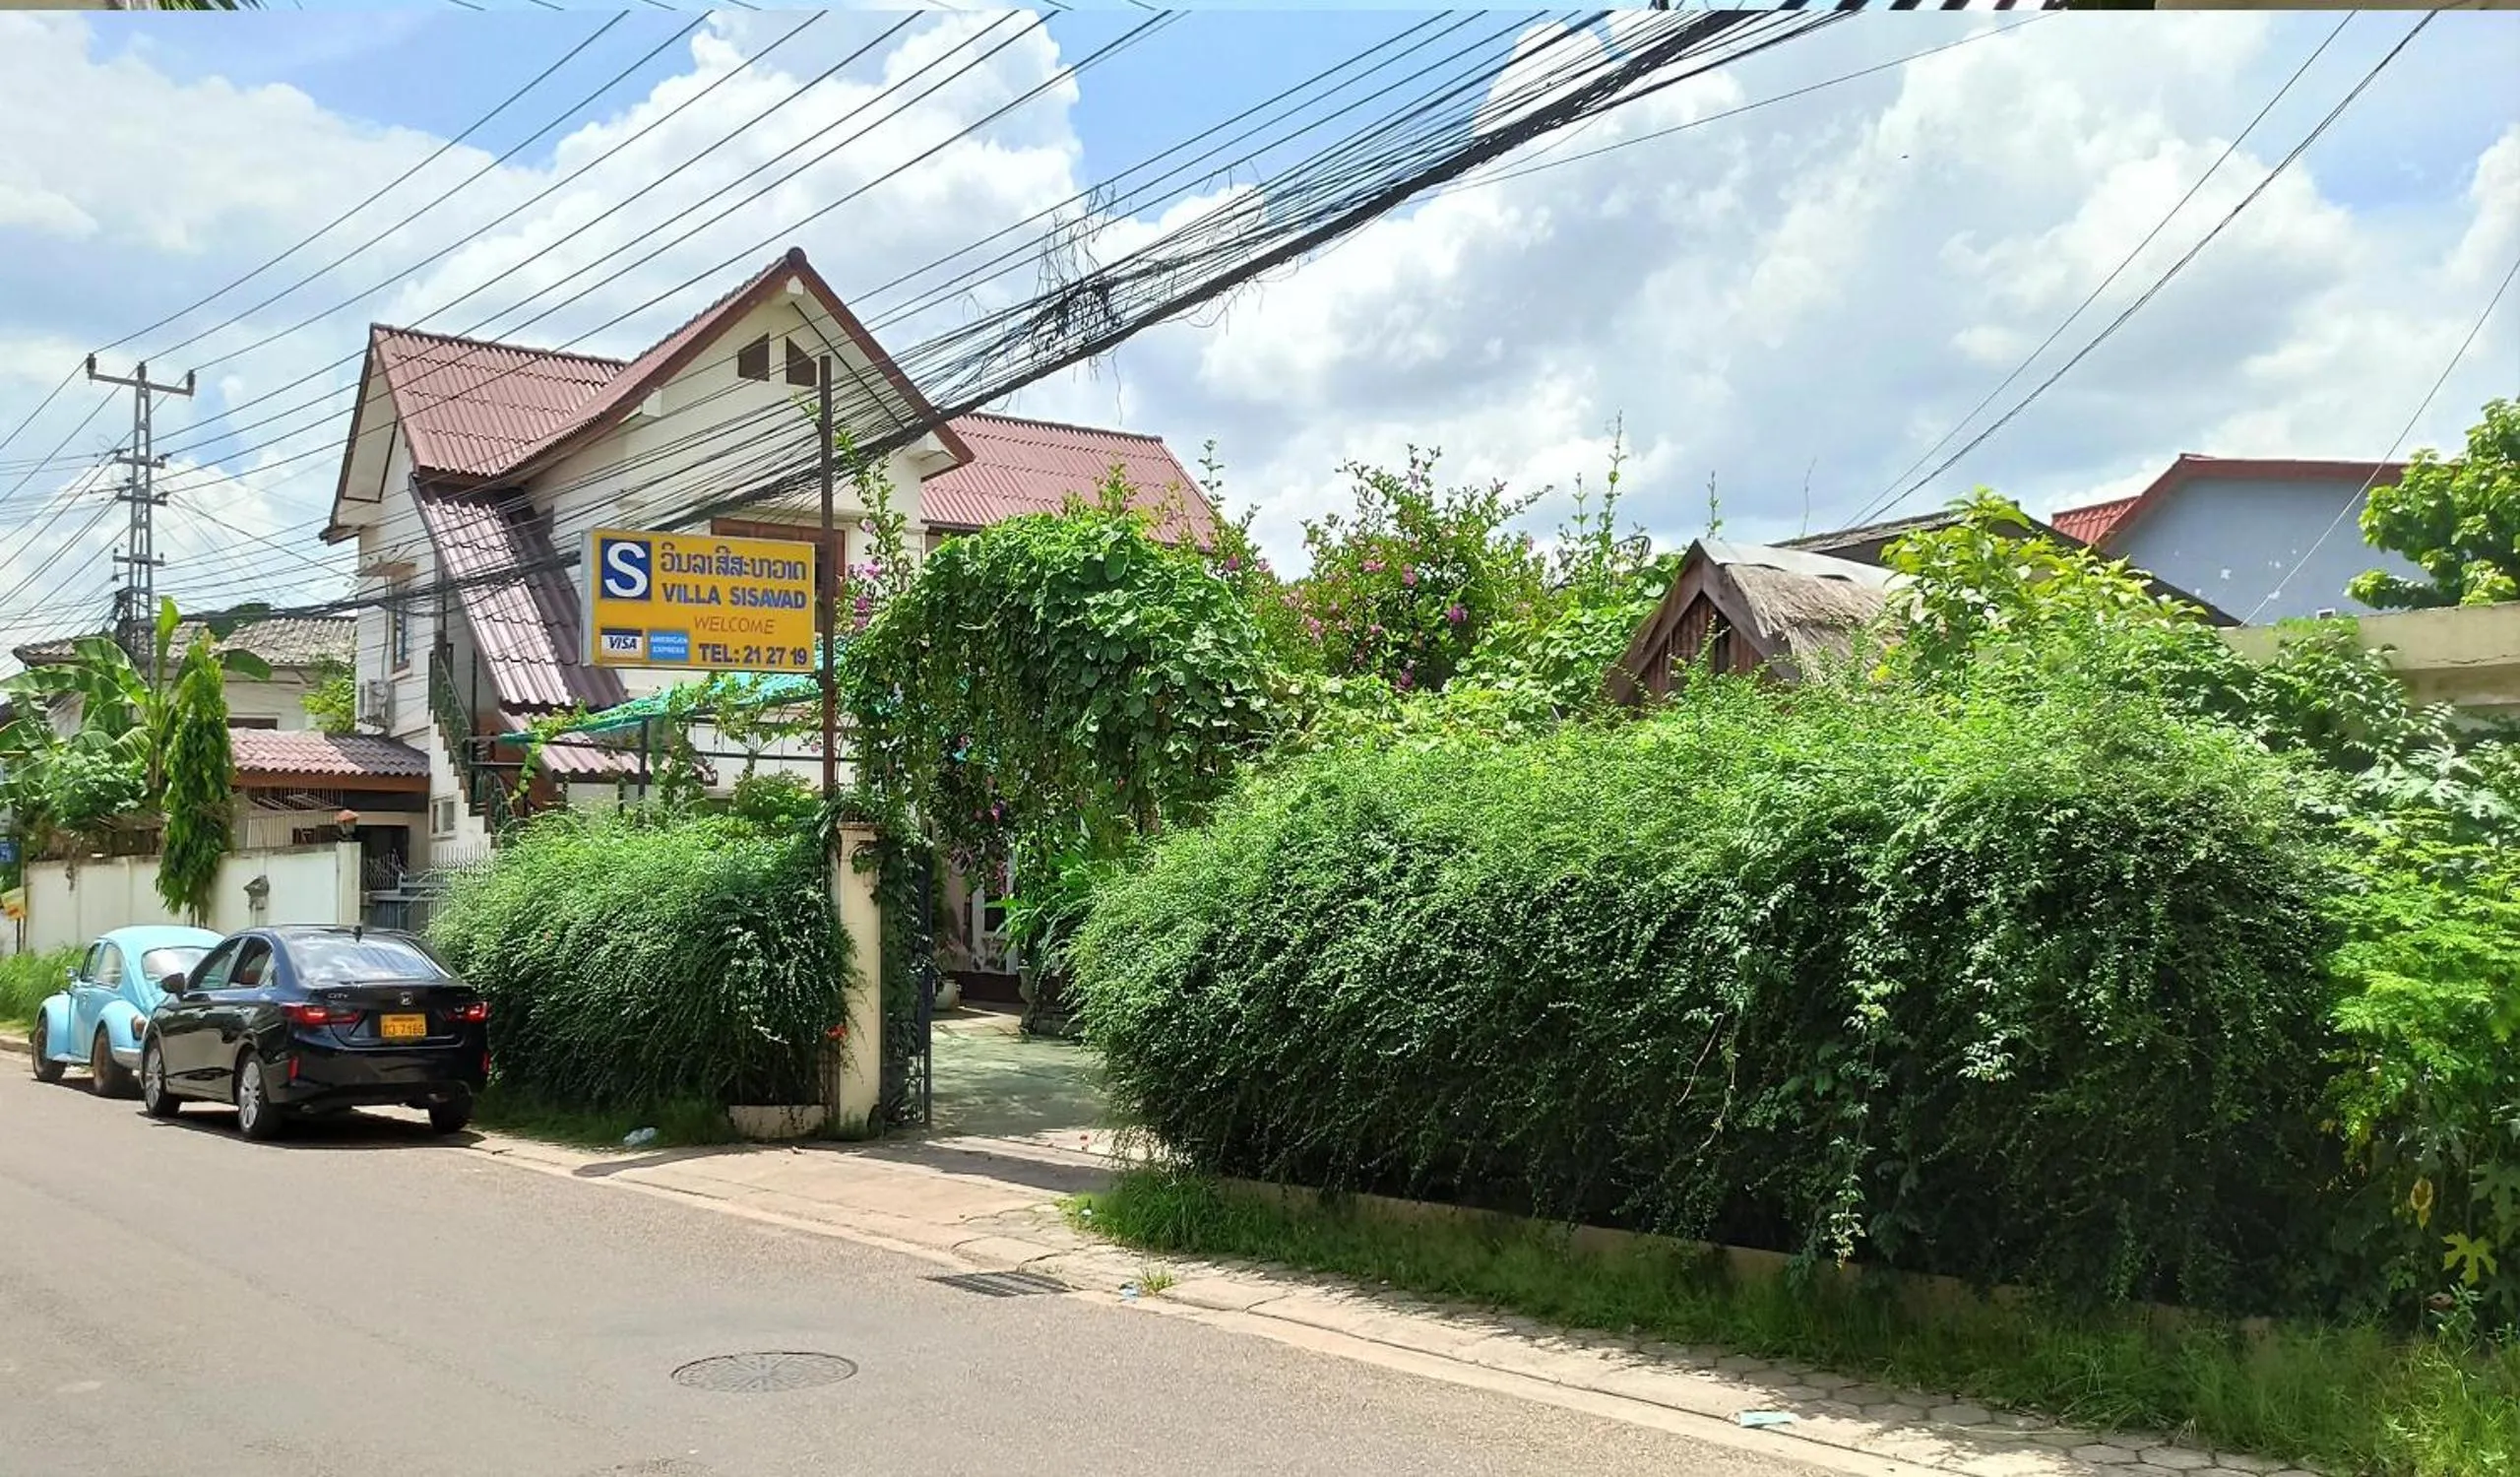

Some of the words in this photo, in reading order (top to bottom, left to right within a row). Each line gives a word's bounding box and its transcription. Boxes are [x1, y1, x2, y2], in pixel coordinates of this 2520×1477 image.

[604, 542, 648, 598] S
[662, 582, 722, 606] VILLA
[729, 586, 807, 609] SISAVAD
[694, 615, 776, 635] WELCOME
[608, 636, 638, 650] VISA
[698, 643, 739, 663] TEL:
[743, 645, 761, 664] 21
[766, 647, 787, 666] 27
[790, 648, 808, 666] 19
